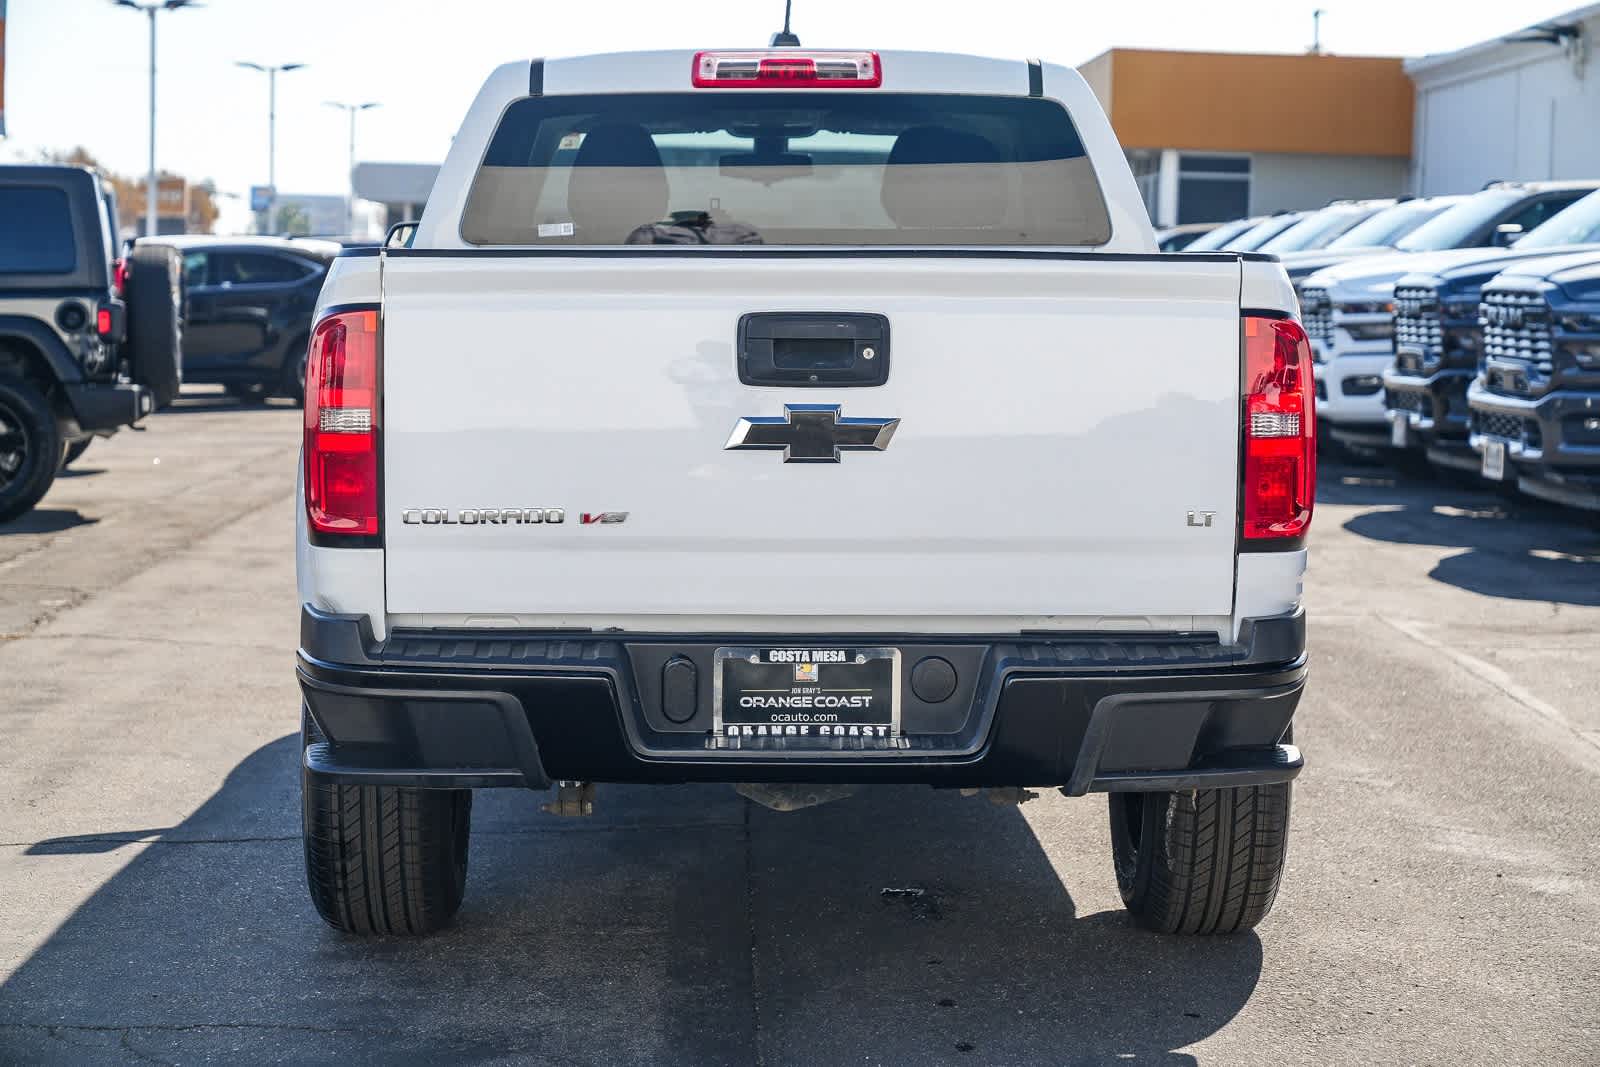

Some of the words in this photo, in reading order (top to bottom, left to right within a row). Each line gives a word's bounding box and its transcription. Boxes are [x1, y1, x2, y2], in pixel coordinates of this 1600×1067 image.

[402, 508, 565, 525] COLORADO
[1187, 510, 1216, 527] LT
[769, 650, 810, 662] COSTA
[812, 650, 846, 662] MESA
[739, 696, 812, 708] ORANGE
[814, 696, 873, 708] COAST
[771, 712, 838, 722] ocauto.com
[727, 725, 809, 736] ORANGE
[819, 725, 888, 736] COAST
